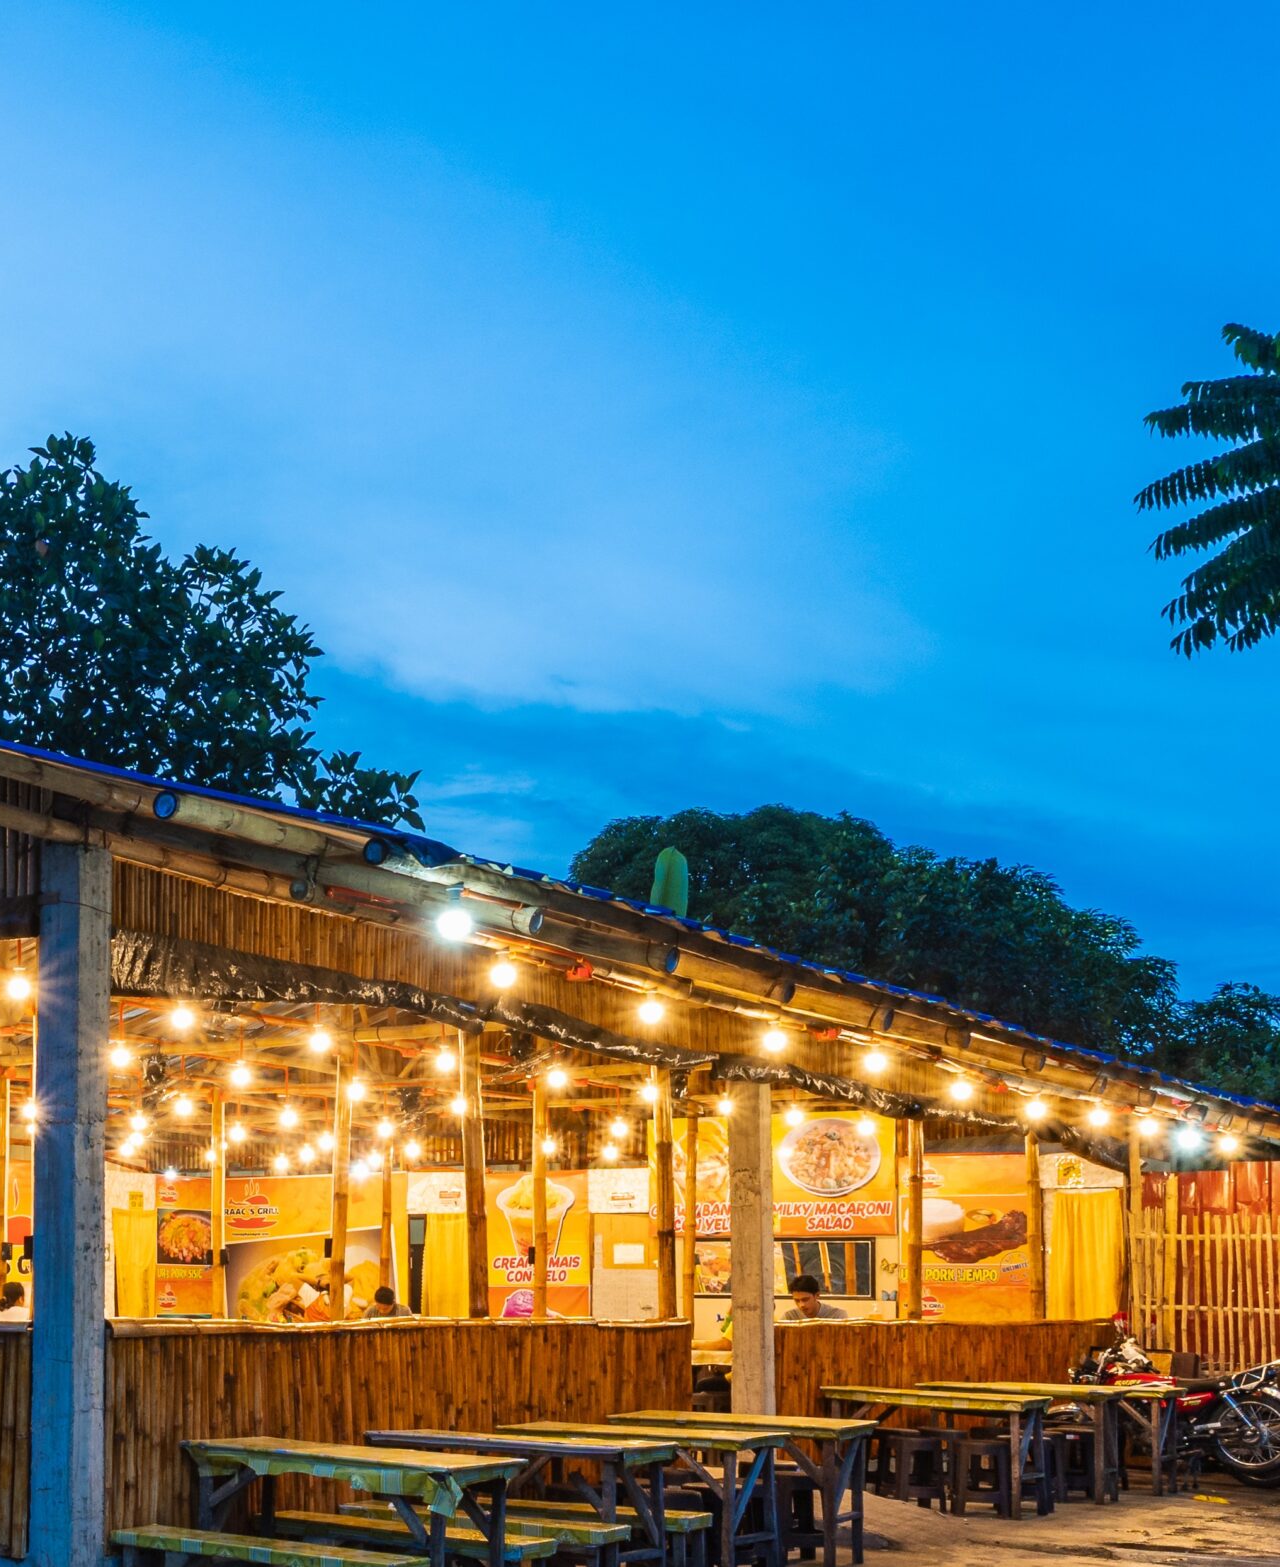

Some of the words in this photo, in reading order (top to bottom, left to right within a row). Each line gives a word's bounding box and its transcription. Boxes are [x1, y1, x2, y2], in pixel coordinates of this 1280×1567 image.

[773, 1202, 812, 1216] MILKY
[814, 1202, 891, 1217] MACARONI
[807, 1217, 852, 1230] SALAD
[548, 1256, 581, 1269] MAIS
[506, 1270, 532, 1282] CON
[925, 1268, 955, 1282] PORK
